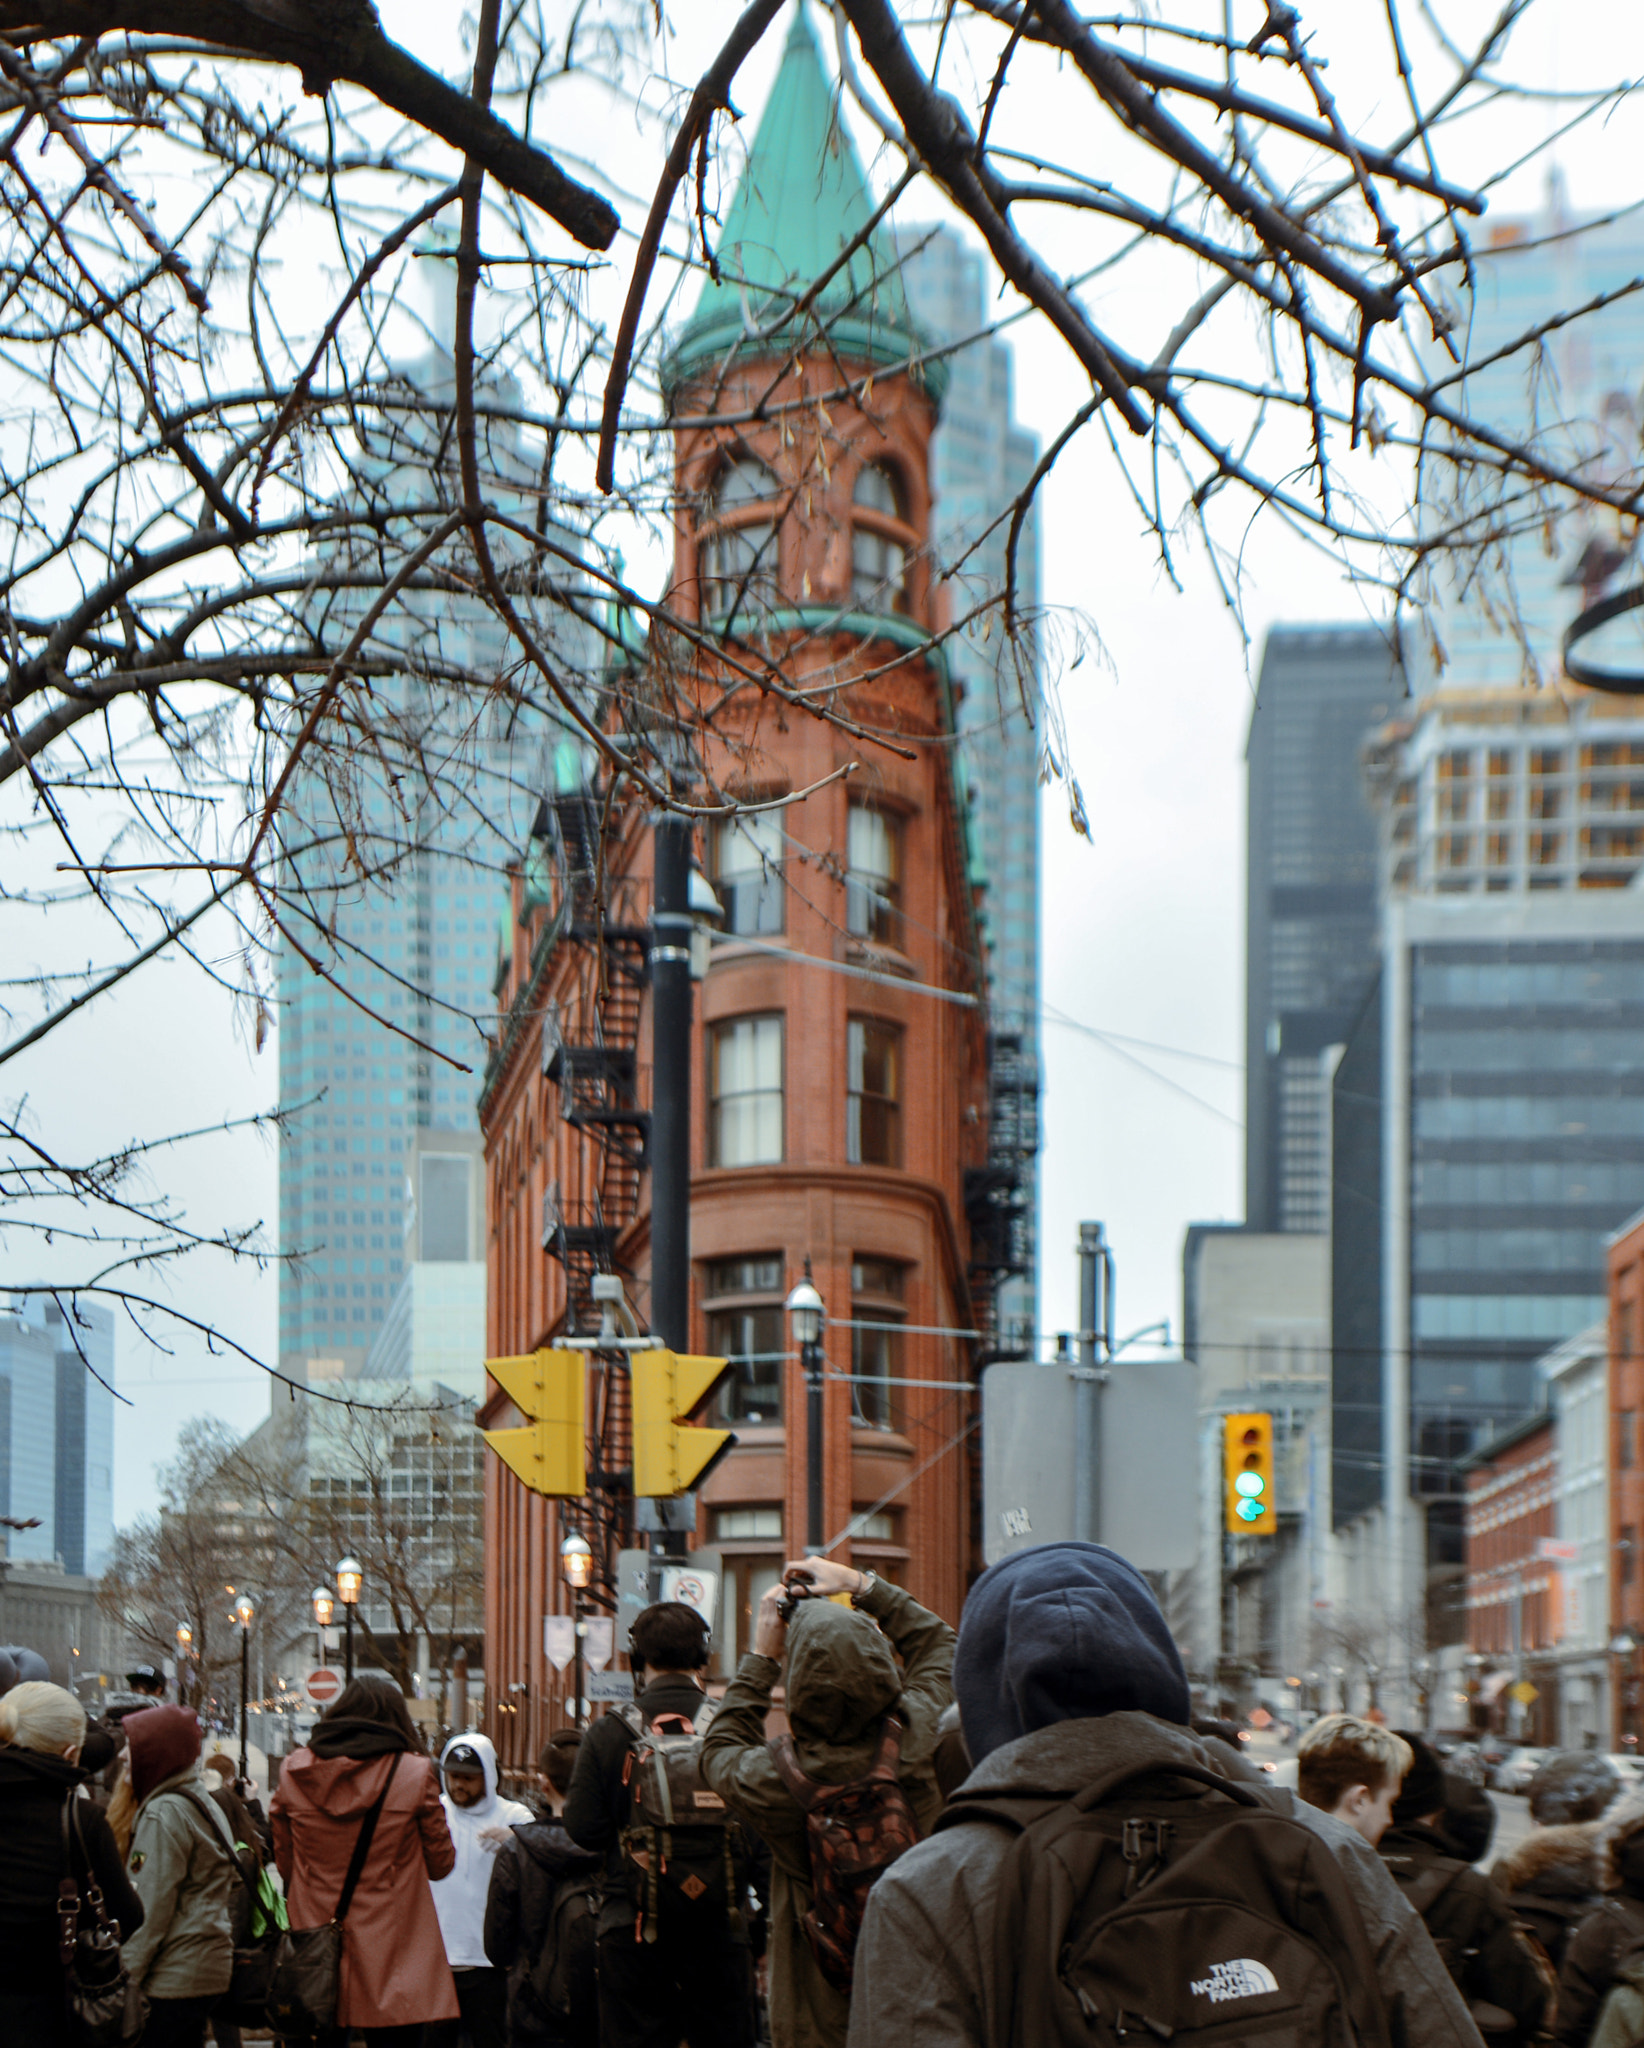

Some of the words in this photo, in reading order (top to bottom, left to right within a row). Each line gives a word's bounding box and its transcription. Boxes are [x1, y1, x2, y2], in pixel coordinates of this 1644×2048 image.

[1209, 1961, 1242, 1977] THE
[1190, 1972, 1246, 1996] NORTH
[1209, 1984, 1250, 2003] FACE
